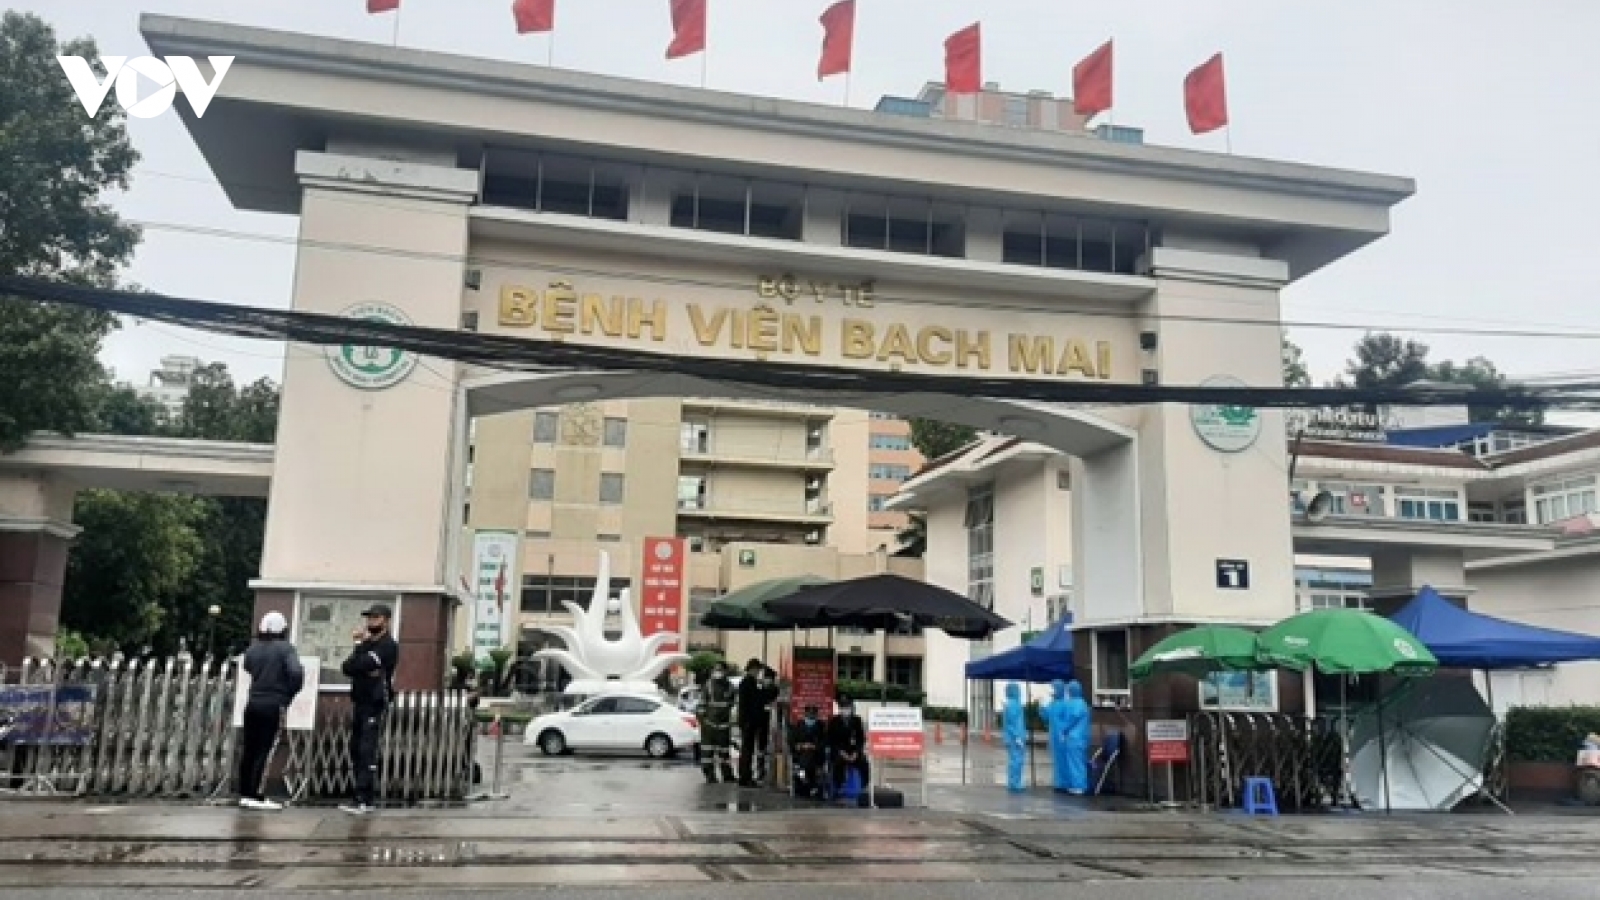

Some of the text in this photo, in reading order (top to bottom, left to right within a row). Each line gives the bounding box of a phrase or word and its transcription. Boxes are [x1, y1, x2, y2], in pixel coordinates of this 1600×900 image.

[758, 274, 802, 306] BỘ
[808, 280, 833, 303] Y
[497, 279, 1112, 379] BỆNH VIỆN BẠCH MAI
[1223, 570, 1239, 587] 1
